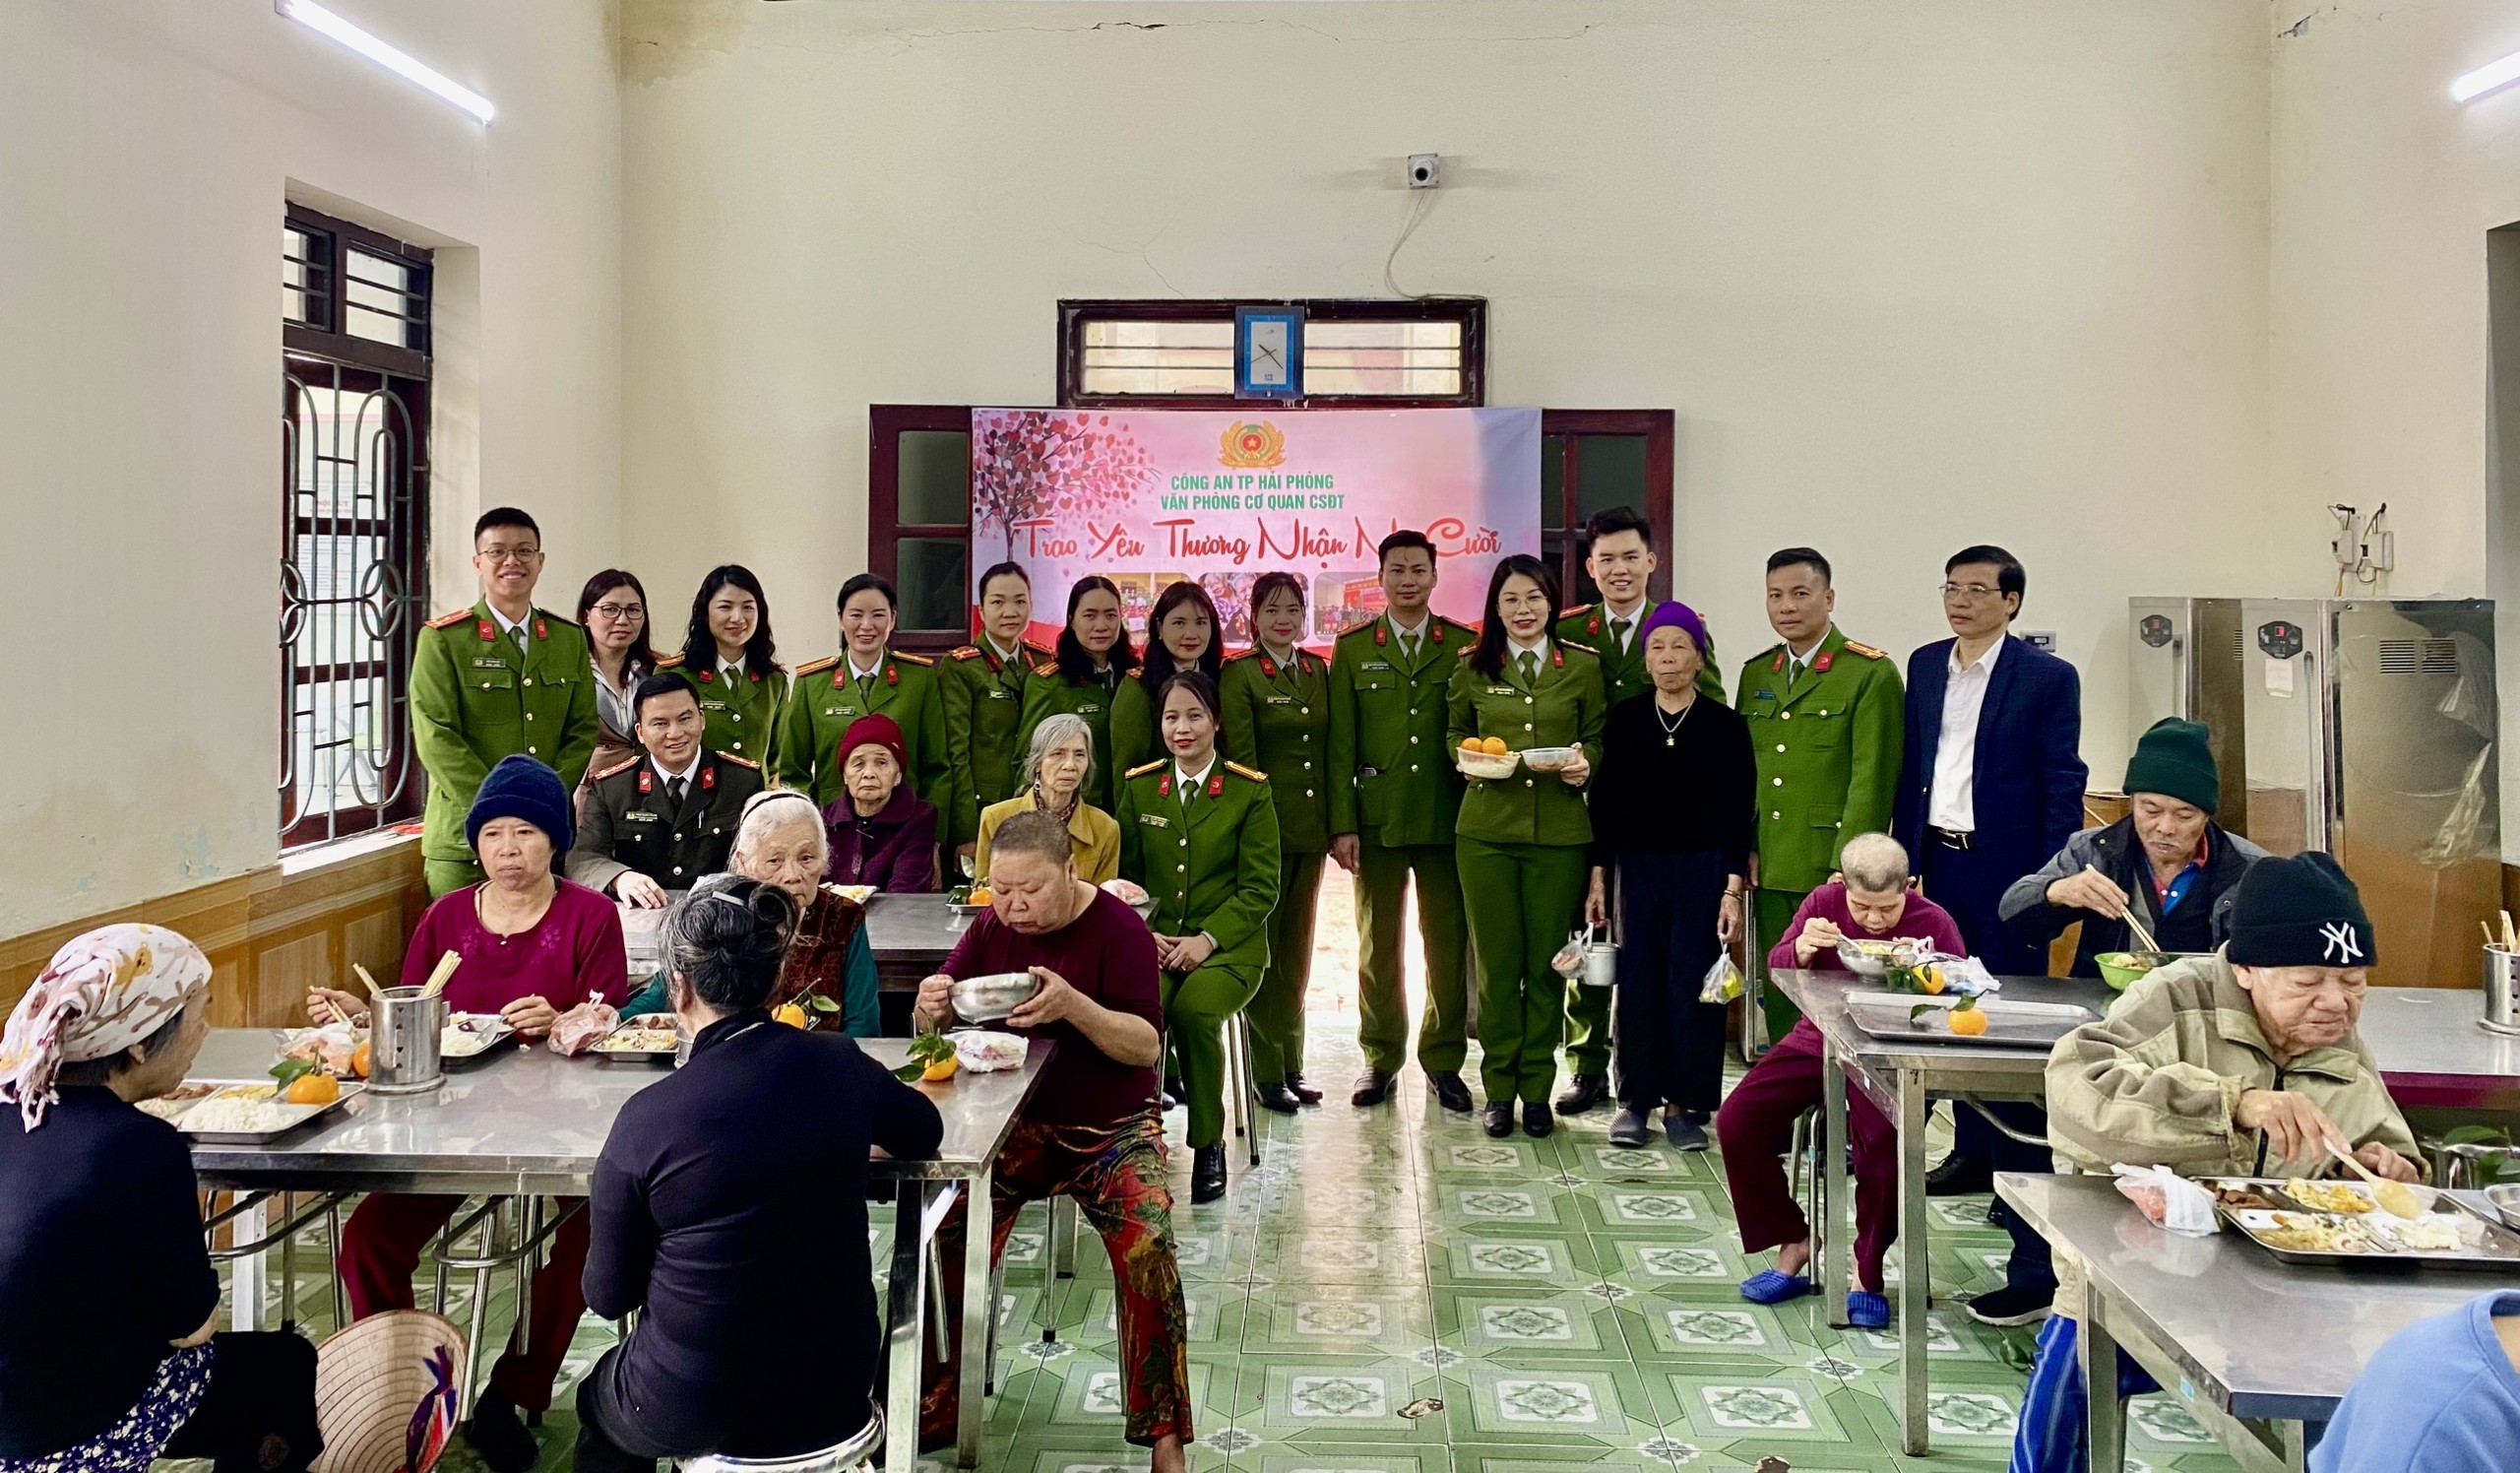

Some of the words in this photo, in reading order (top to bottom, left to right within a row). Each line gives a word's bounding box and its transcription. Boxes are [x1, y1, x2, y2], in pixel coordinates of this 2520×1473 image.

[1171, 473, 1210, 490] CÔNG
[1214, 475, 1233, 490] AN
[1237, 475, 1254, 490] TP
[1259, 470, 1282, 489] HẢI
[1287, 471, 1334, 489] PHÒNG
[1161, 492, 1188, 510] VĂN
[1193, 491, 1240, 510] PHÒNG
[1244, 493, 1264, 510] CƠ
[1267, 494, 1304, 511] QUAN
[1309, 494, 1345, 509] CSĐT
[1012, 518, 1079, 559] Trao
[1087, 520, 1145, 560] Yêu
[1153, 518, 1251, 565] Thương
[1257, 516, 1348, 569] Nhận
[1425, 517, 1501, 558] Cười
[2318, 922, 2364, 965] NY
